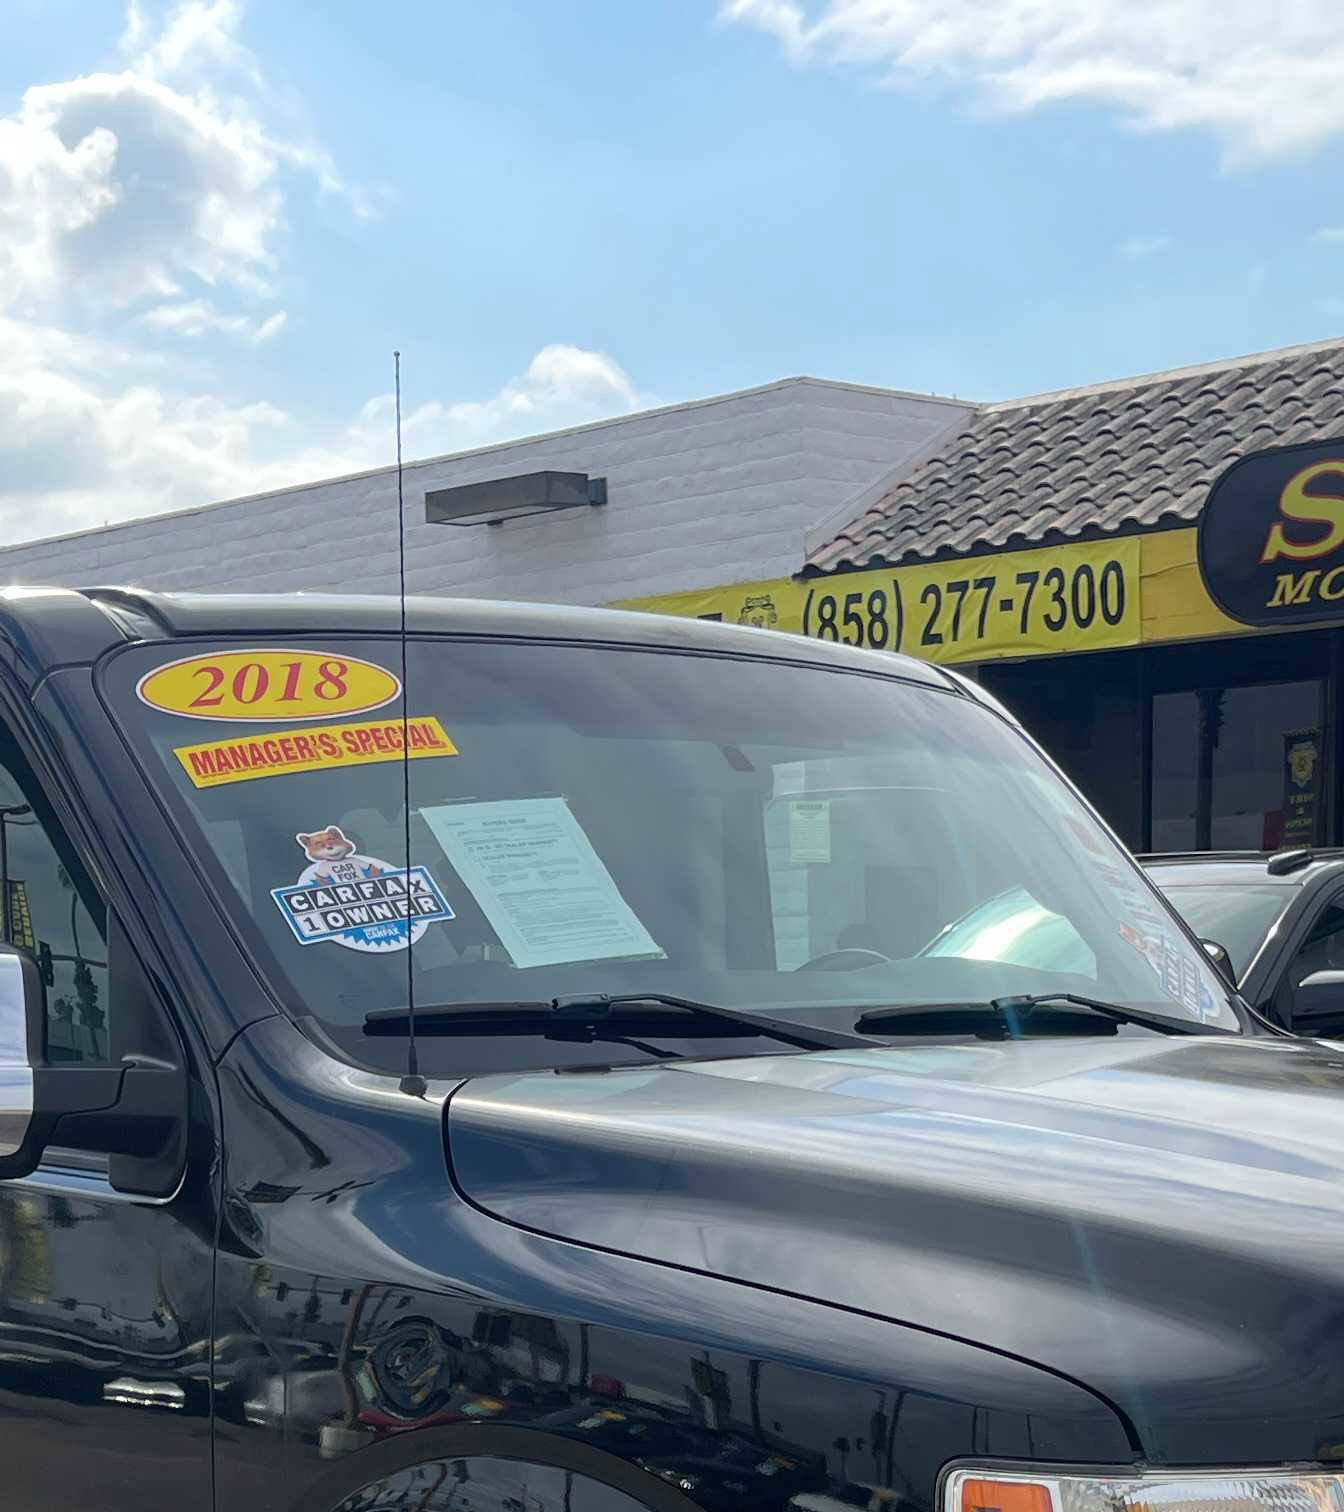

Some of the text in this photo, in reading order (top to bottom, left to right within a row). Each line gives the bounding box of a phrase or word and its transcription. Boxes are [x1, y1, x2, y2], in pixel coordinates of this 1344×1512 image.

[802, 560, 1126, 653] (858) 277-7300
[188, 660, 349, 708] 2018
[188, 723, 445, 777] MANAGER'S SPECIAL
[290, 876, 426, 912] CARFAX
[332, 864, 360, 882] CAR FOX
[326, 898, 438, 929] OWNER
